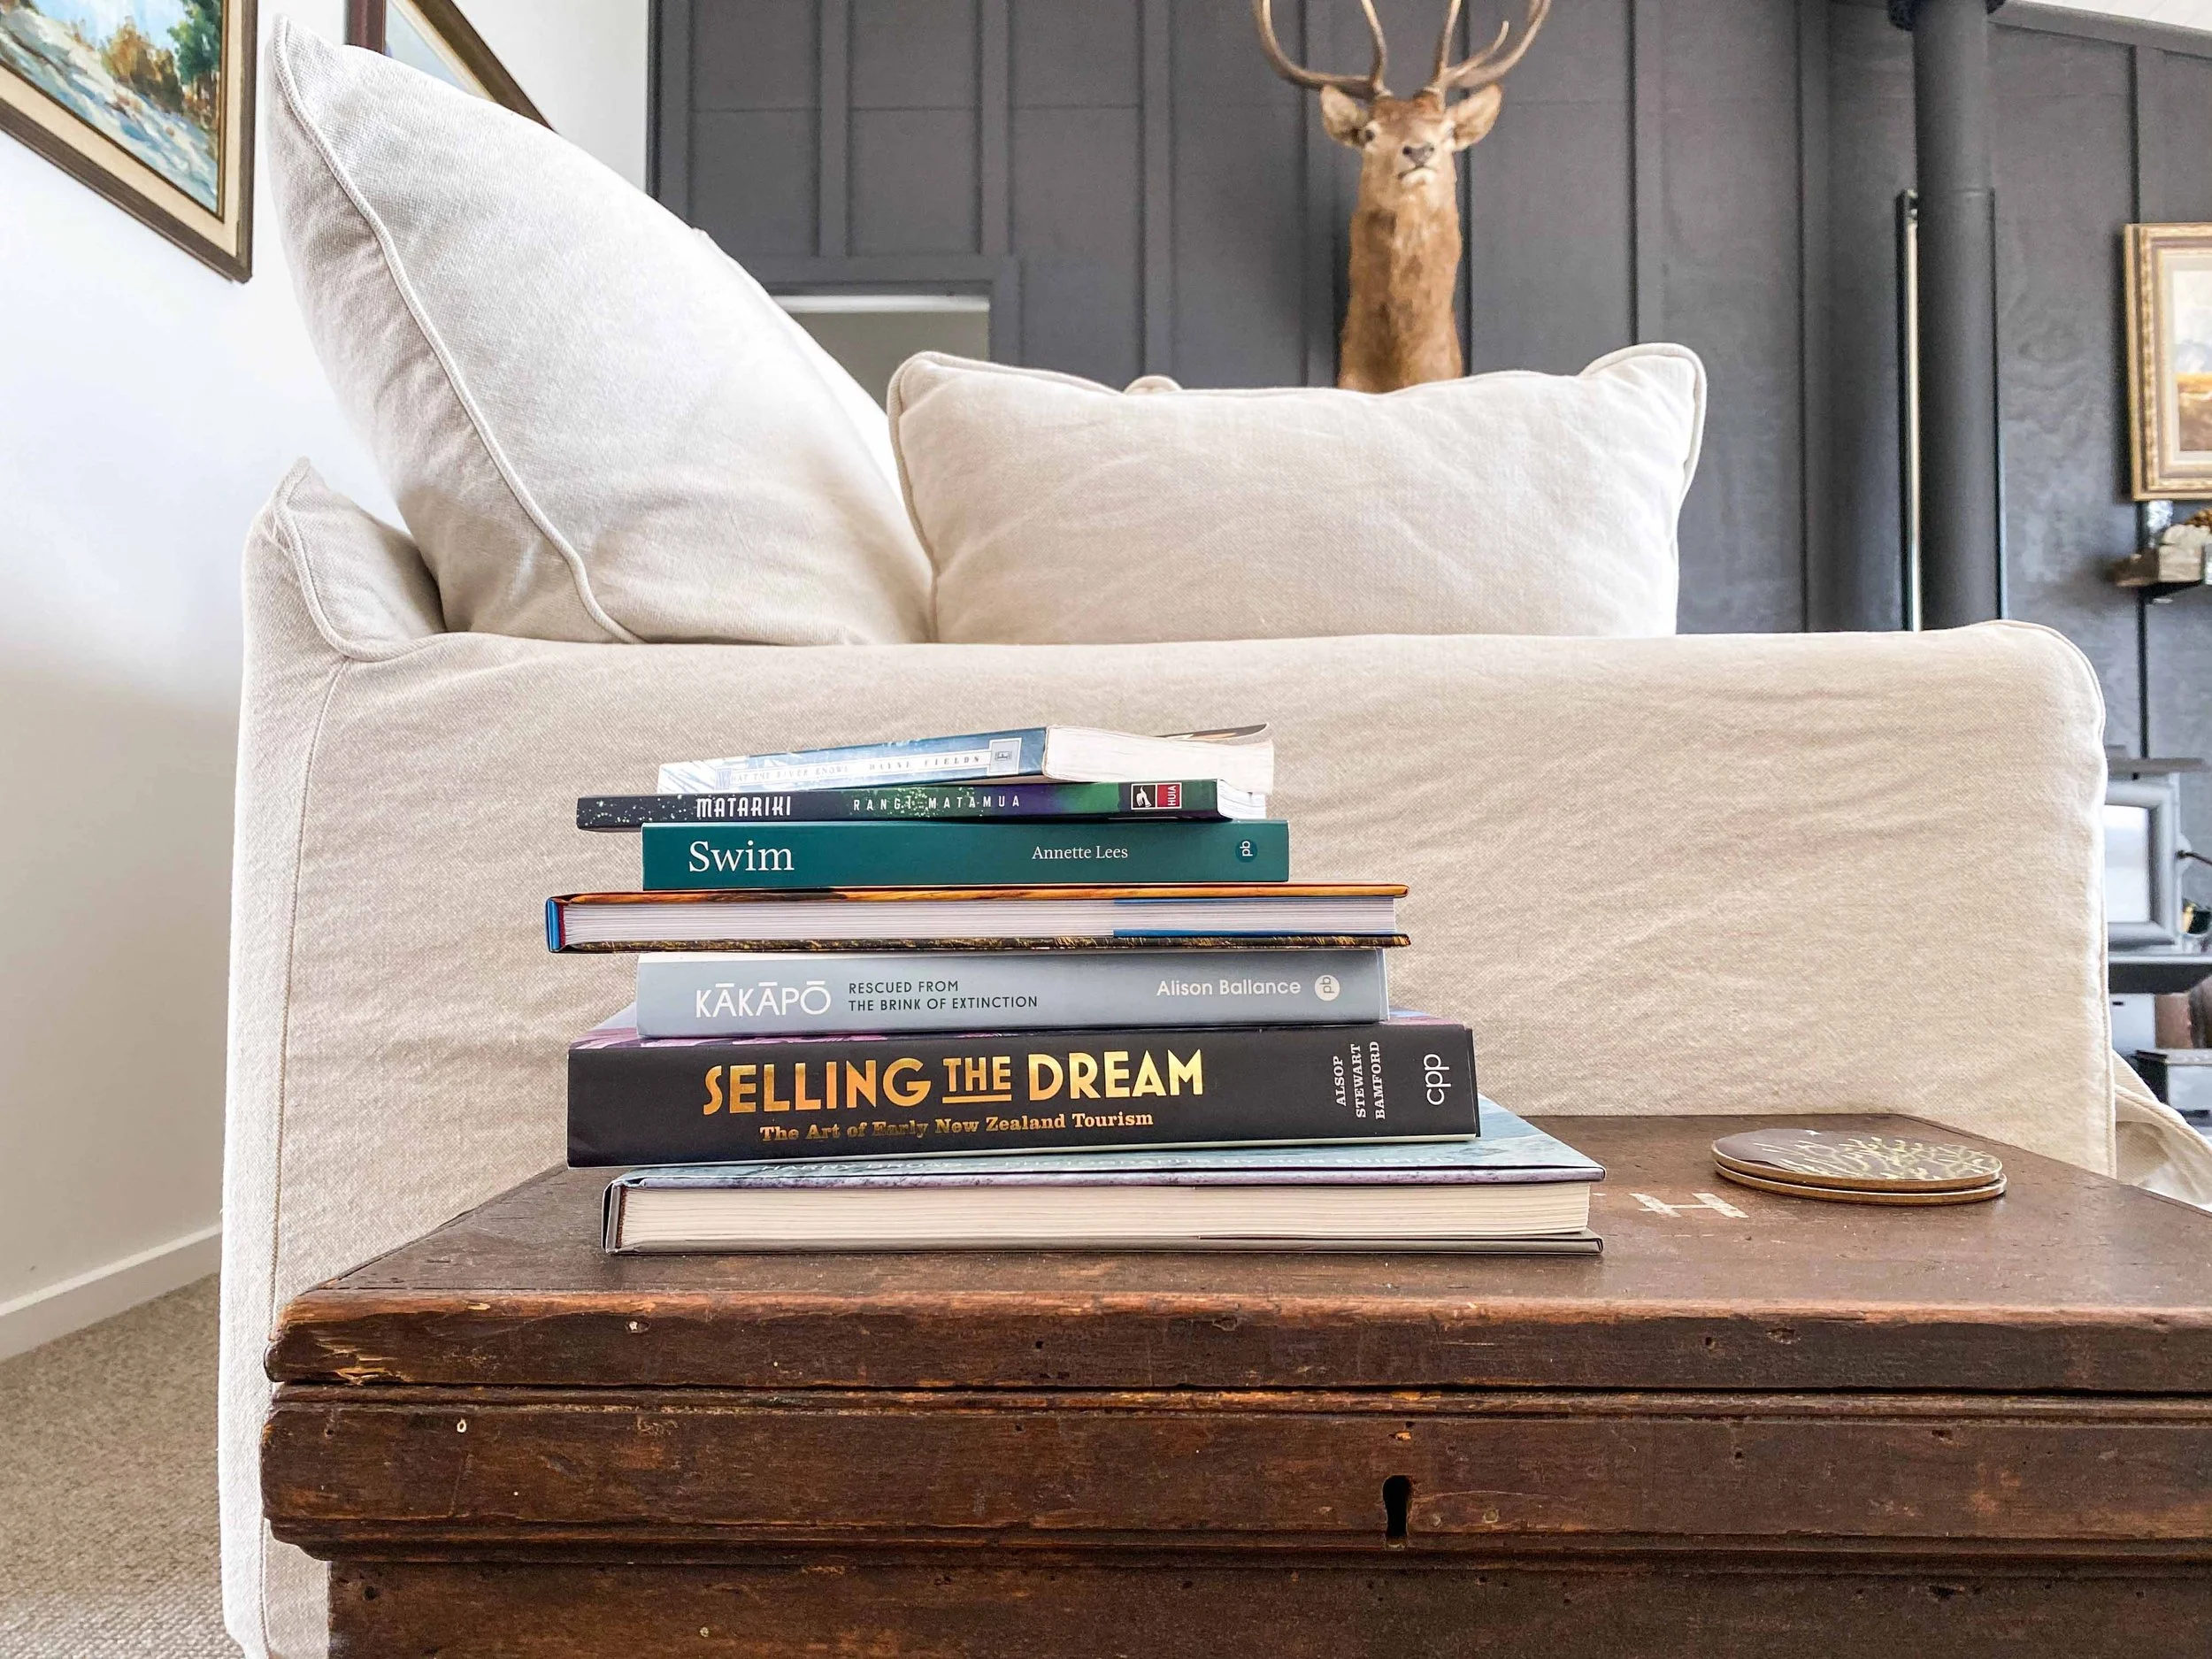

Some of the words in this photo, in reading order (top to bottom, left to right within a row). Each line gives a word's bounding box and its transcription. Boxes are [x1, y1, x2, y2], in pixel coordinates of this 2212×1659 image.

[923, 756, 980, 767] FIELDS
[696, 795, 791, 818] MATARIKI
[853, 795, 911, 811] RANGI
[1167, 785, 1177, 806] HUIA
[688, 840, 795, 872] Swim
[1031, 845, 1091, 860] Annette
[1095, 845, 1128, 859] Lees
[695, 980, 832, 1018] KĀKĀPŌ
[849, 982, 912, 995] RESCUED
[918, 980, 959, 993] FROM
[1156, 979, 1213, 996] Alison
[1219, 979, 1302, 995] Ballance
[849, 1000, 874, 1011] THE
[880, 999, 920, 1011] BRINK
[927, 997, 946, 1010] OF
[951, 995, 1038, 1010] EXTINCTION
[703, 1057, 932, 1116] SELLING
[942, 1056, 1012, 1093] THE
[1028, 1048, 1203, 1102] DREAM
[1333, 1056, 1347, 1107] ALSOP
[1350, 1043, 1367, 1118] STEWART
[1369, 1041, 1386, 1120] BAMFORD
[1423, 1053, 1452, 1106] cpp
[759, 1125, 799, 1141] The
[805, 1124, 840, 1140] Art
[847, 1121, 867, 1138] of
[872, 1119, 929, 1139] Early
[933, 1118, 979, 1134] New
[985, 1113, 1066, 1132] Zealand
[1071, 1111, 1154, 1128] Tourism
